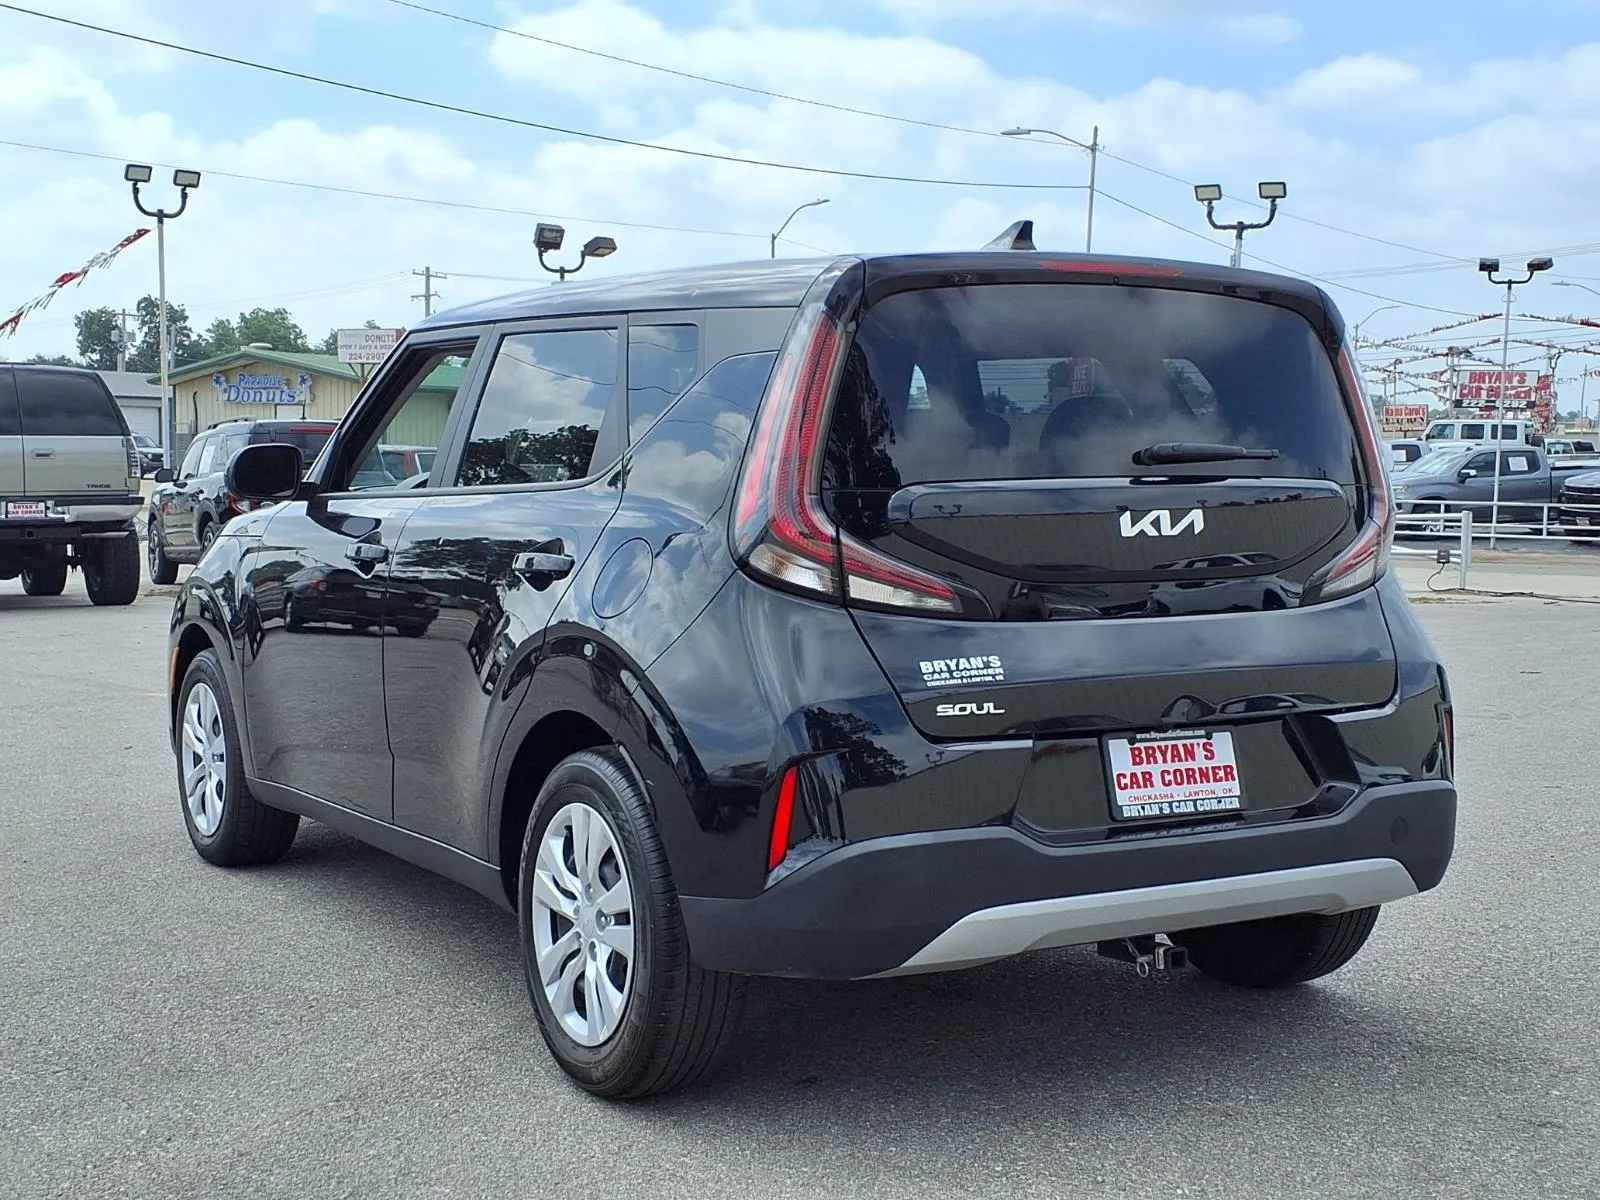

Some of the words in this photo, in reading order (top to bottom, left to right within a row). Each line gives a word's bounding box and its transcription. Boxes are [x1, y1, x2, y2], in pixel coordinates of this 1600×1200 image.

[365, 335, 395, 343] DONUTS
[226, 385, 297, 403] Donuts
[1119, 508, 1205, 538] KIA
[920, 655, 1002, 674] BRYAN'S
[923, 672, 950, 681] CAR
[952, 667, 1004, 678] CORNER
[936, 702, 1005, 716] SOUL
[1129, 741, 1215, 767] BRYAN'S
[1115, 771, 1155, 791] CAR
[1160, 764, 1236, 788] CORNER
[1128, 792, 1175, 803] CHICKASHA
[1183, 789, 1219, 798] LAWTON,
[1122, 802, 1170, 817] BRYAN'S
[1172, 799, 1195, 814] CAR
[1196, 797, 1240, 812] CORNER
